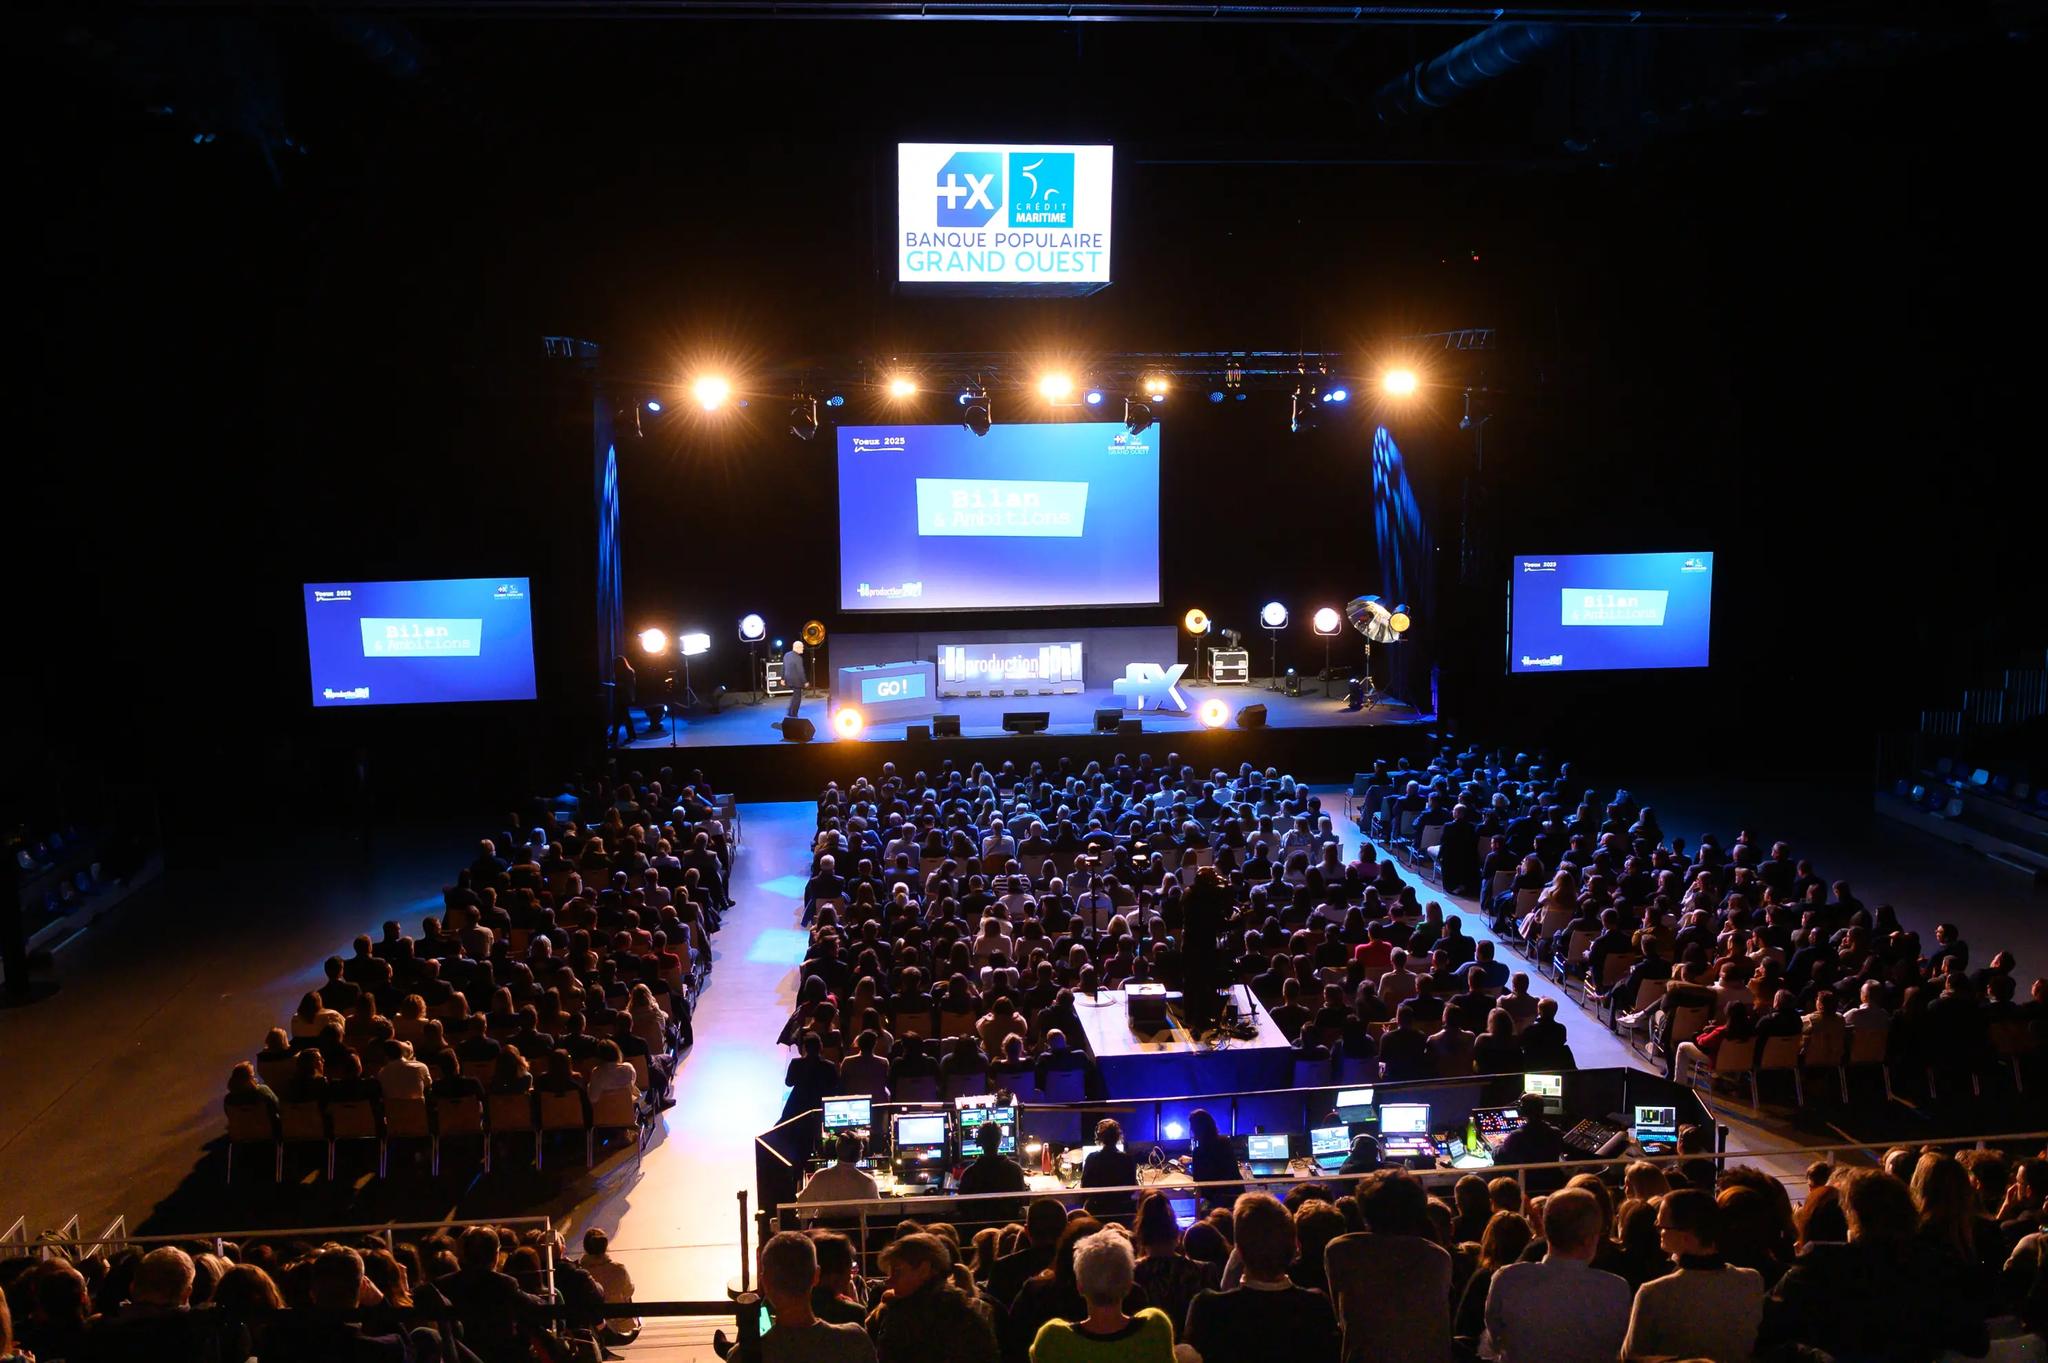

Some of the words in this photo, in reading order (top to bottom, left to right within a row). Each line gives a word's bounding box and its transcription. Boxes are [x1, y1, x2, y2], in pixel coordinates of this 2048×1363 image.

[1016, 201, 1067, 211] CRÉDIT
[1015, 212, 1067, 223] MARITIME
[906, 232, 987, 248] BANQUE
[995, 233, 1103, 248] POPULAIRE
[906, 250, 1005, 272] GRAND
[1015, 251, 1103, 273] OUEST
[853, 438, 880, 446] Voeux
[884, 437, 905, 445] 2025
[951, 488, 1041, 509] Bilan
[952, 510, 1072, 527] Ambitions
[385, 624, 448, 639] Bilan
